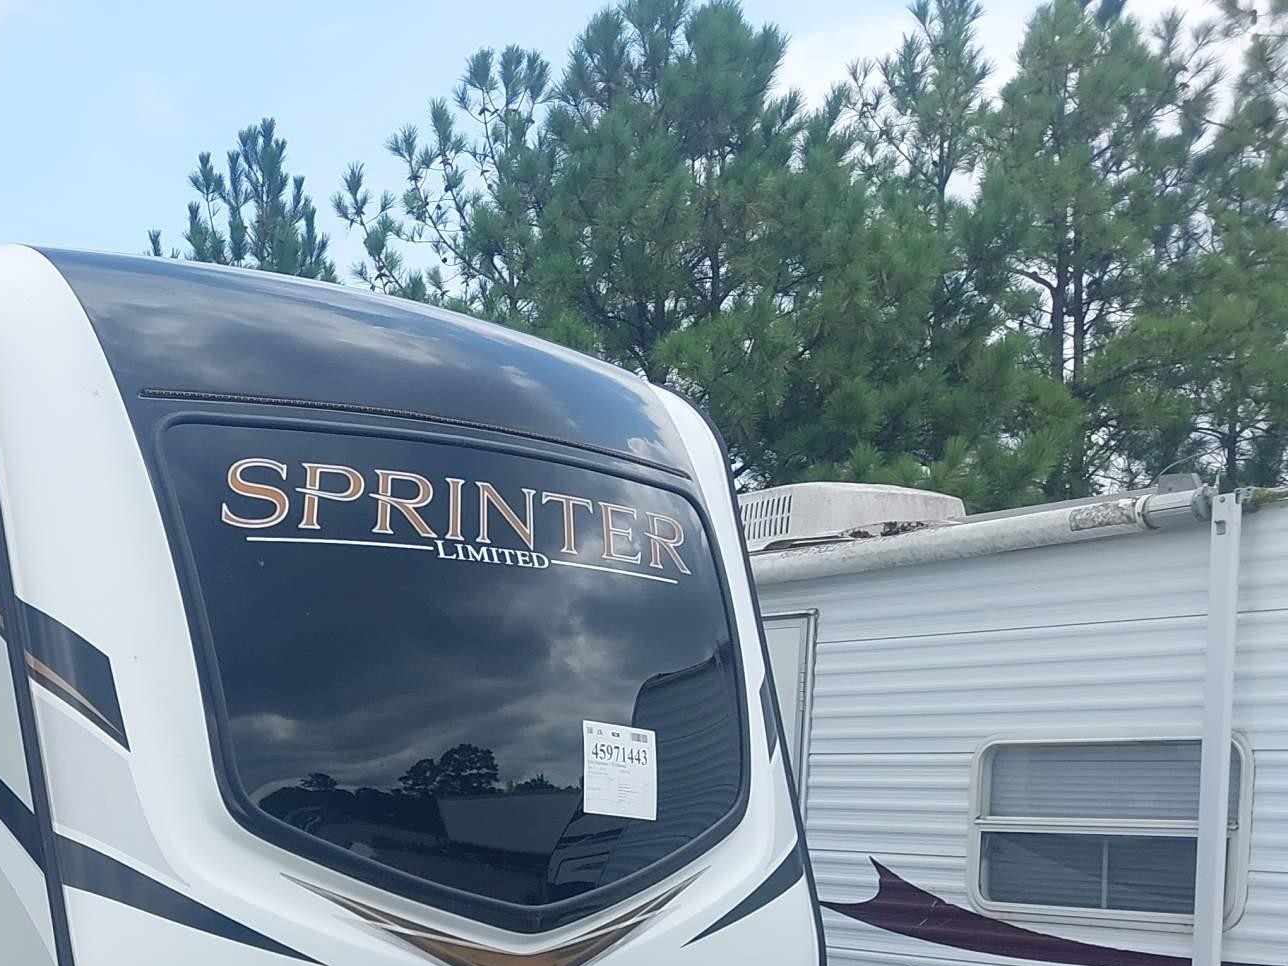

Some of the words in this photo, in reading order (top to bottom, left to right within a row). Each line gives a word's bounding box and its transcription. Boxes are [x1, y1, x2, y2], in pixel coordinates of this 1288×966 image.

[220, 457, 692, 576] SPRINTER
[433, 539, 551, 570] LIMITED
[591, 742, 648, 766] 45971443
